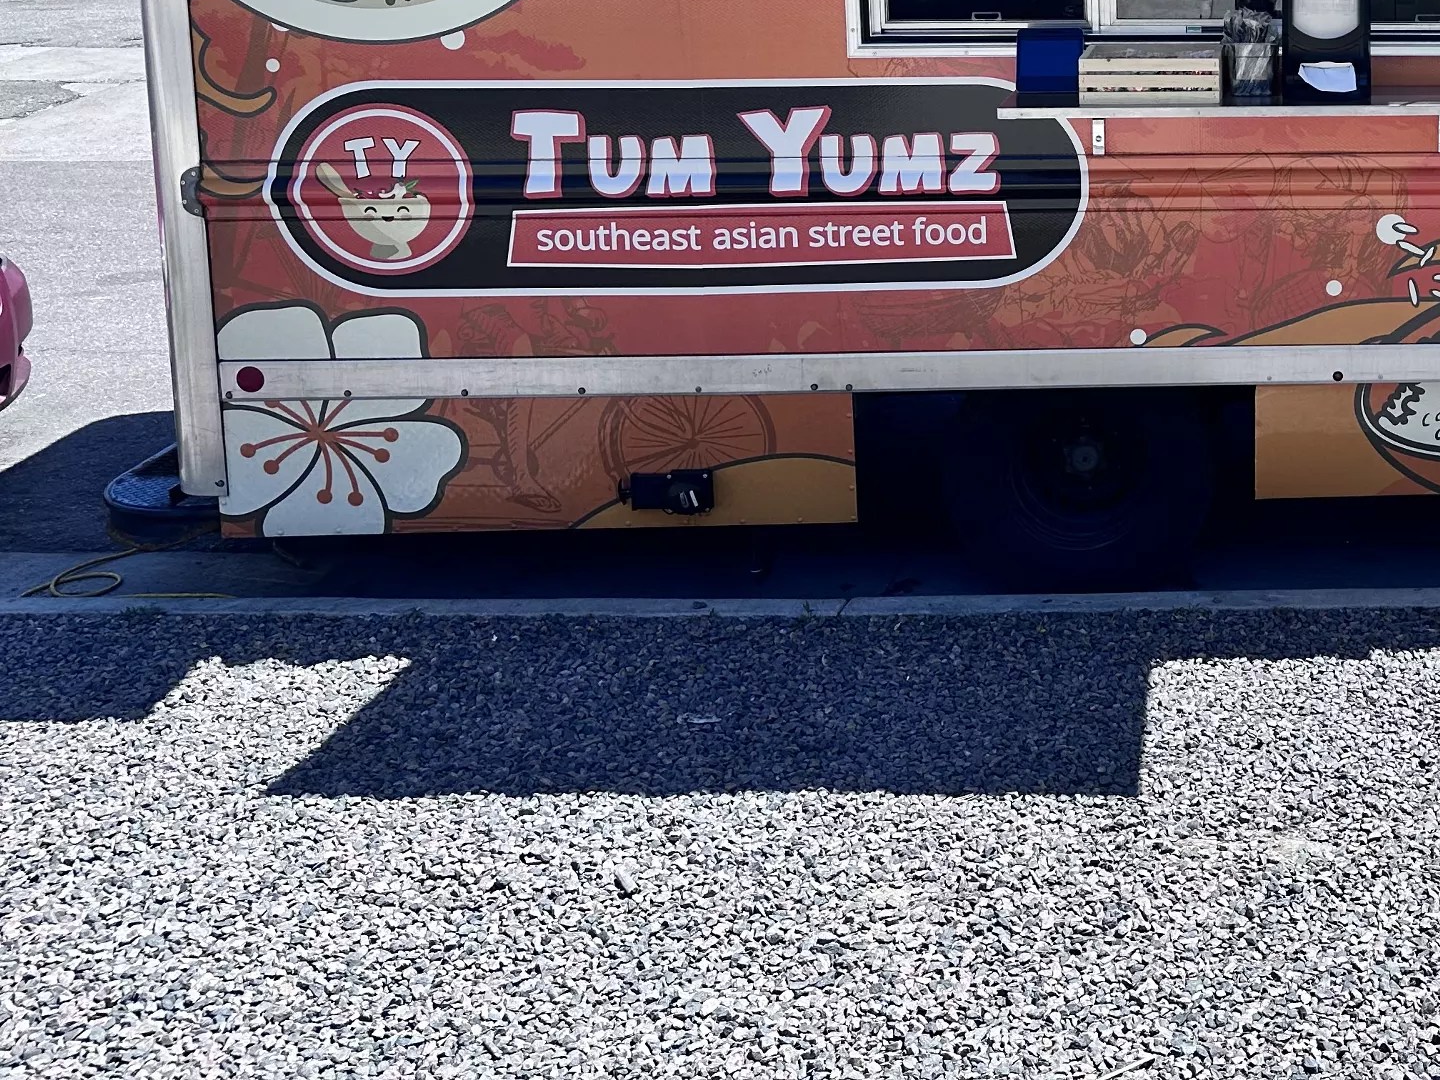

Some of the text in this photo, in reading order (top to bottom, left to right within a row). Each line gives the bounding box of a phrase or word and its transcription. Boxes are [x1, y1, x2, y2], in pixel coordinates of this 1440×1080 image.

[344, 136, 421, 180] TY
[536, 216, 987, 252] southeast asian street food
